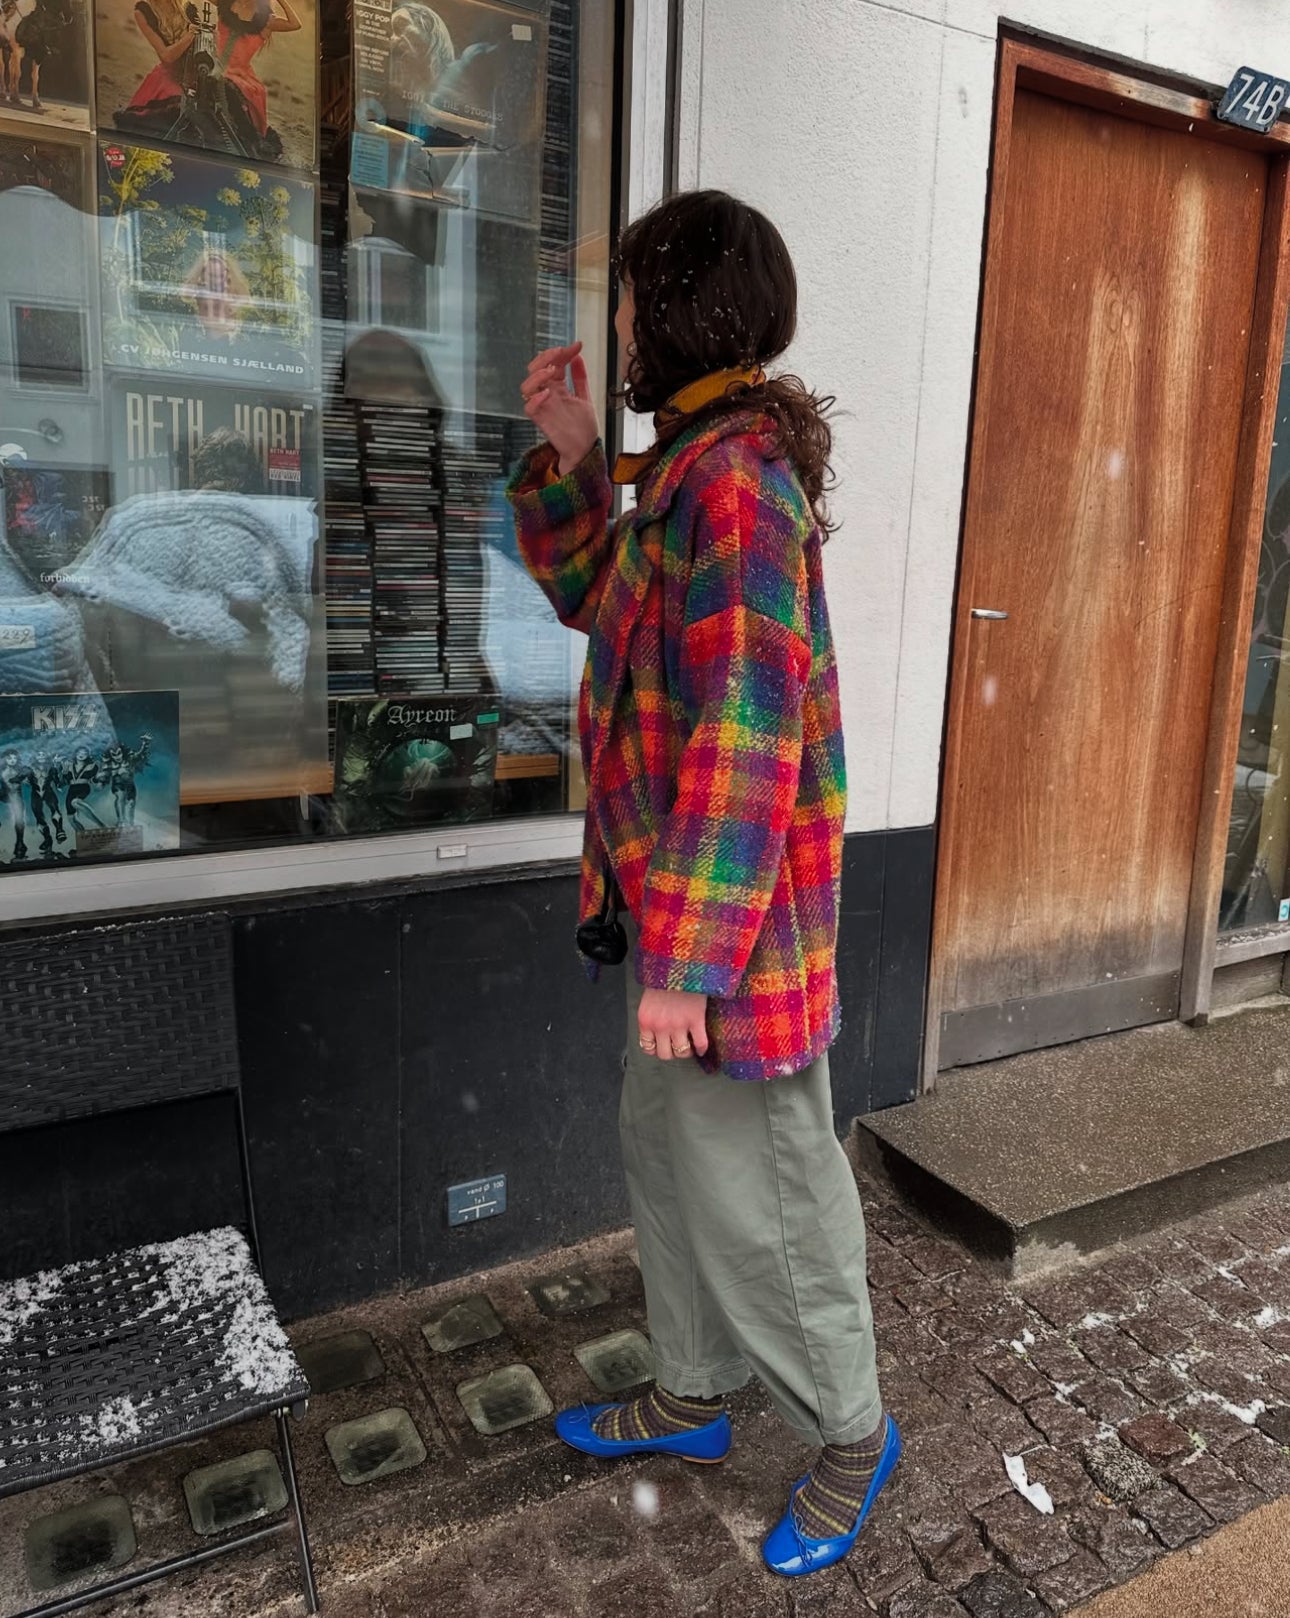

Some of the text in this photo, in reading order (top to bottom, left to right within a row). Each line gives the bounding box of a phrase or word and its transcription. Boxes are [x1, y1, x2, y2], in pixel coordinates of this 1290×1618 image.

[1225, 73, 1285, 125] 74B
[121, 344, 139, 353] CV
[232, 358, 304, 374] SJÆLLAND
[40, 572, 90, 584] forbidden
[31, 703, 99, 731] KISS
[387, 704, 457, 728] Ayreon
